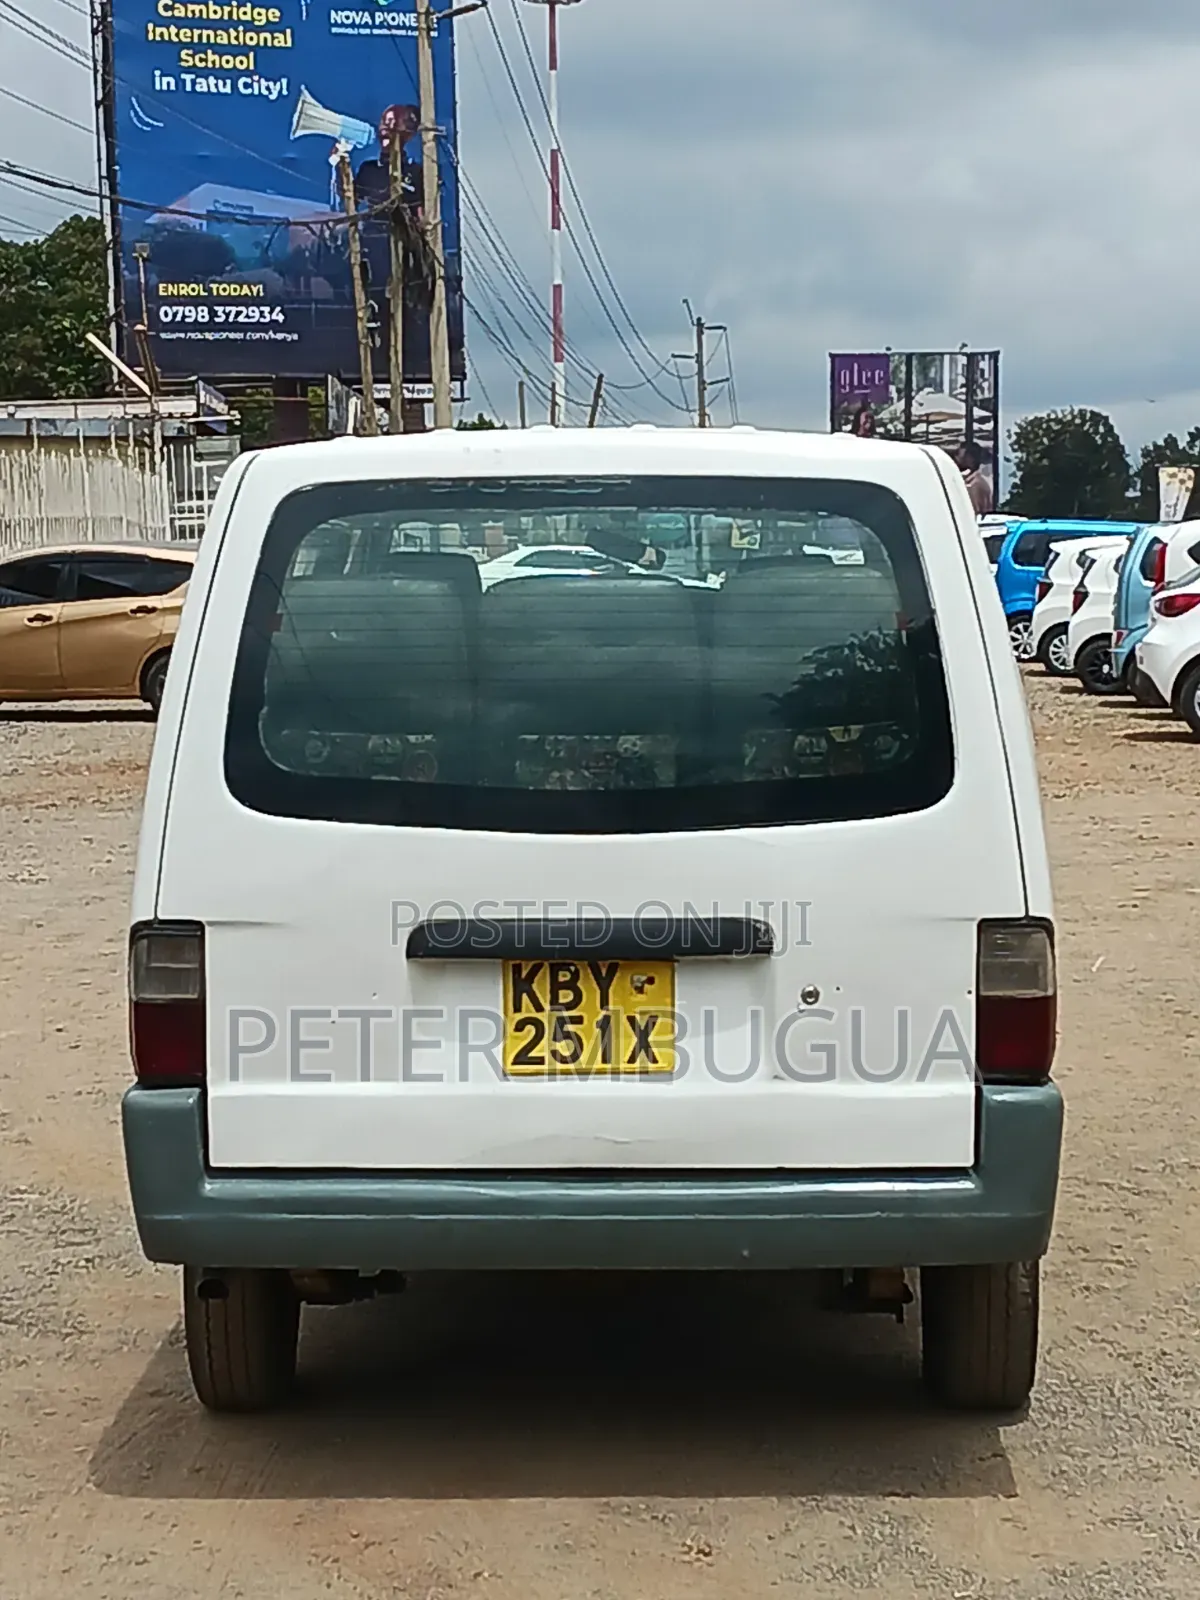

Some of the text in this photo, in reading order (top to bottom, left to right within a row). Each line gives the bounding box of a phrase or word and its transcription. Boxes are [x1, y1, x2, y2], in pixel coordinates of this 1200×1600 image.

[157, 0, 281, 26] Cambridge
[330, 9, 438, 29] NOVA PIONE
[147, 23, 292, 48] International
[179, 49, 255, 70] School
[154, 70, 289, 100] in Tatu City!
[158, 283, 265, 297] ENROL TODAY!
[159, 306, 285, 323] 0798 372934
[840, 363, 884, 393] glee
[510, 960, 620, 1014] KBY
[510, 1014, 660, 1066] 251X
